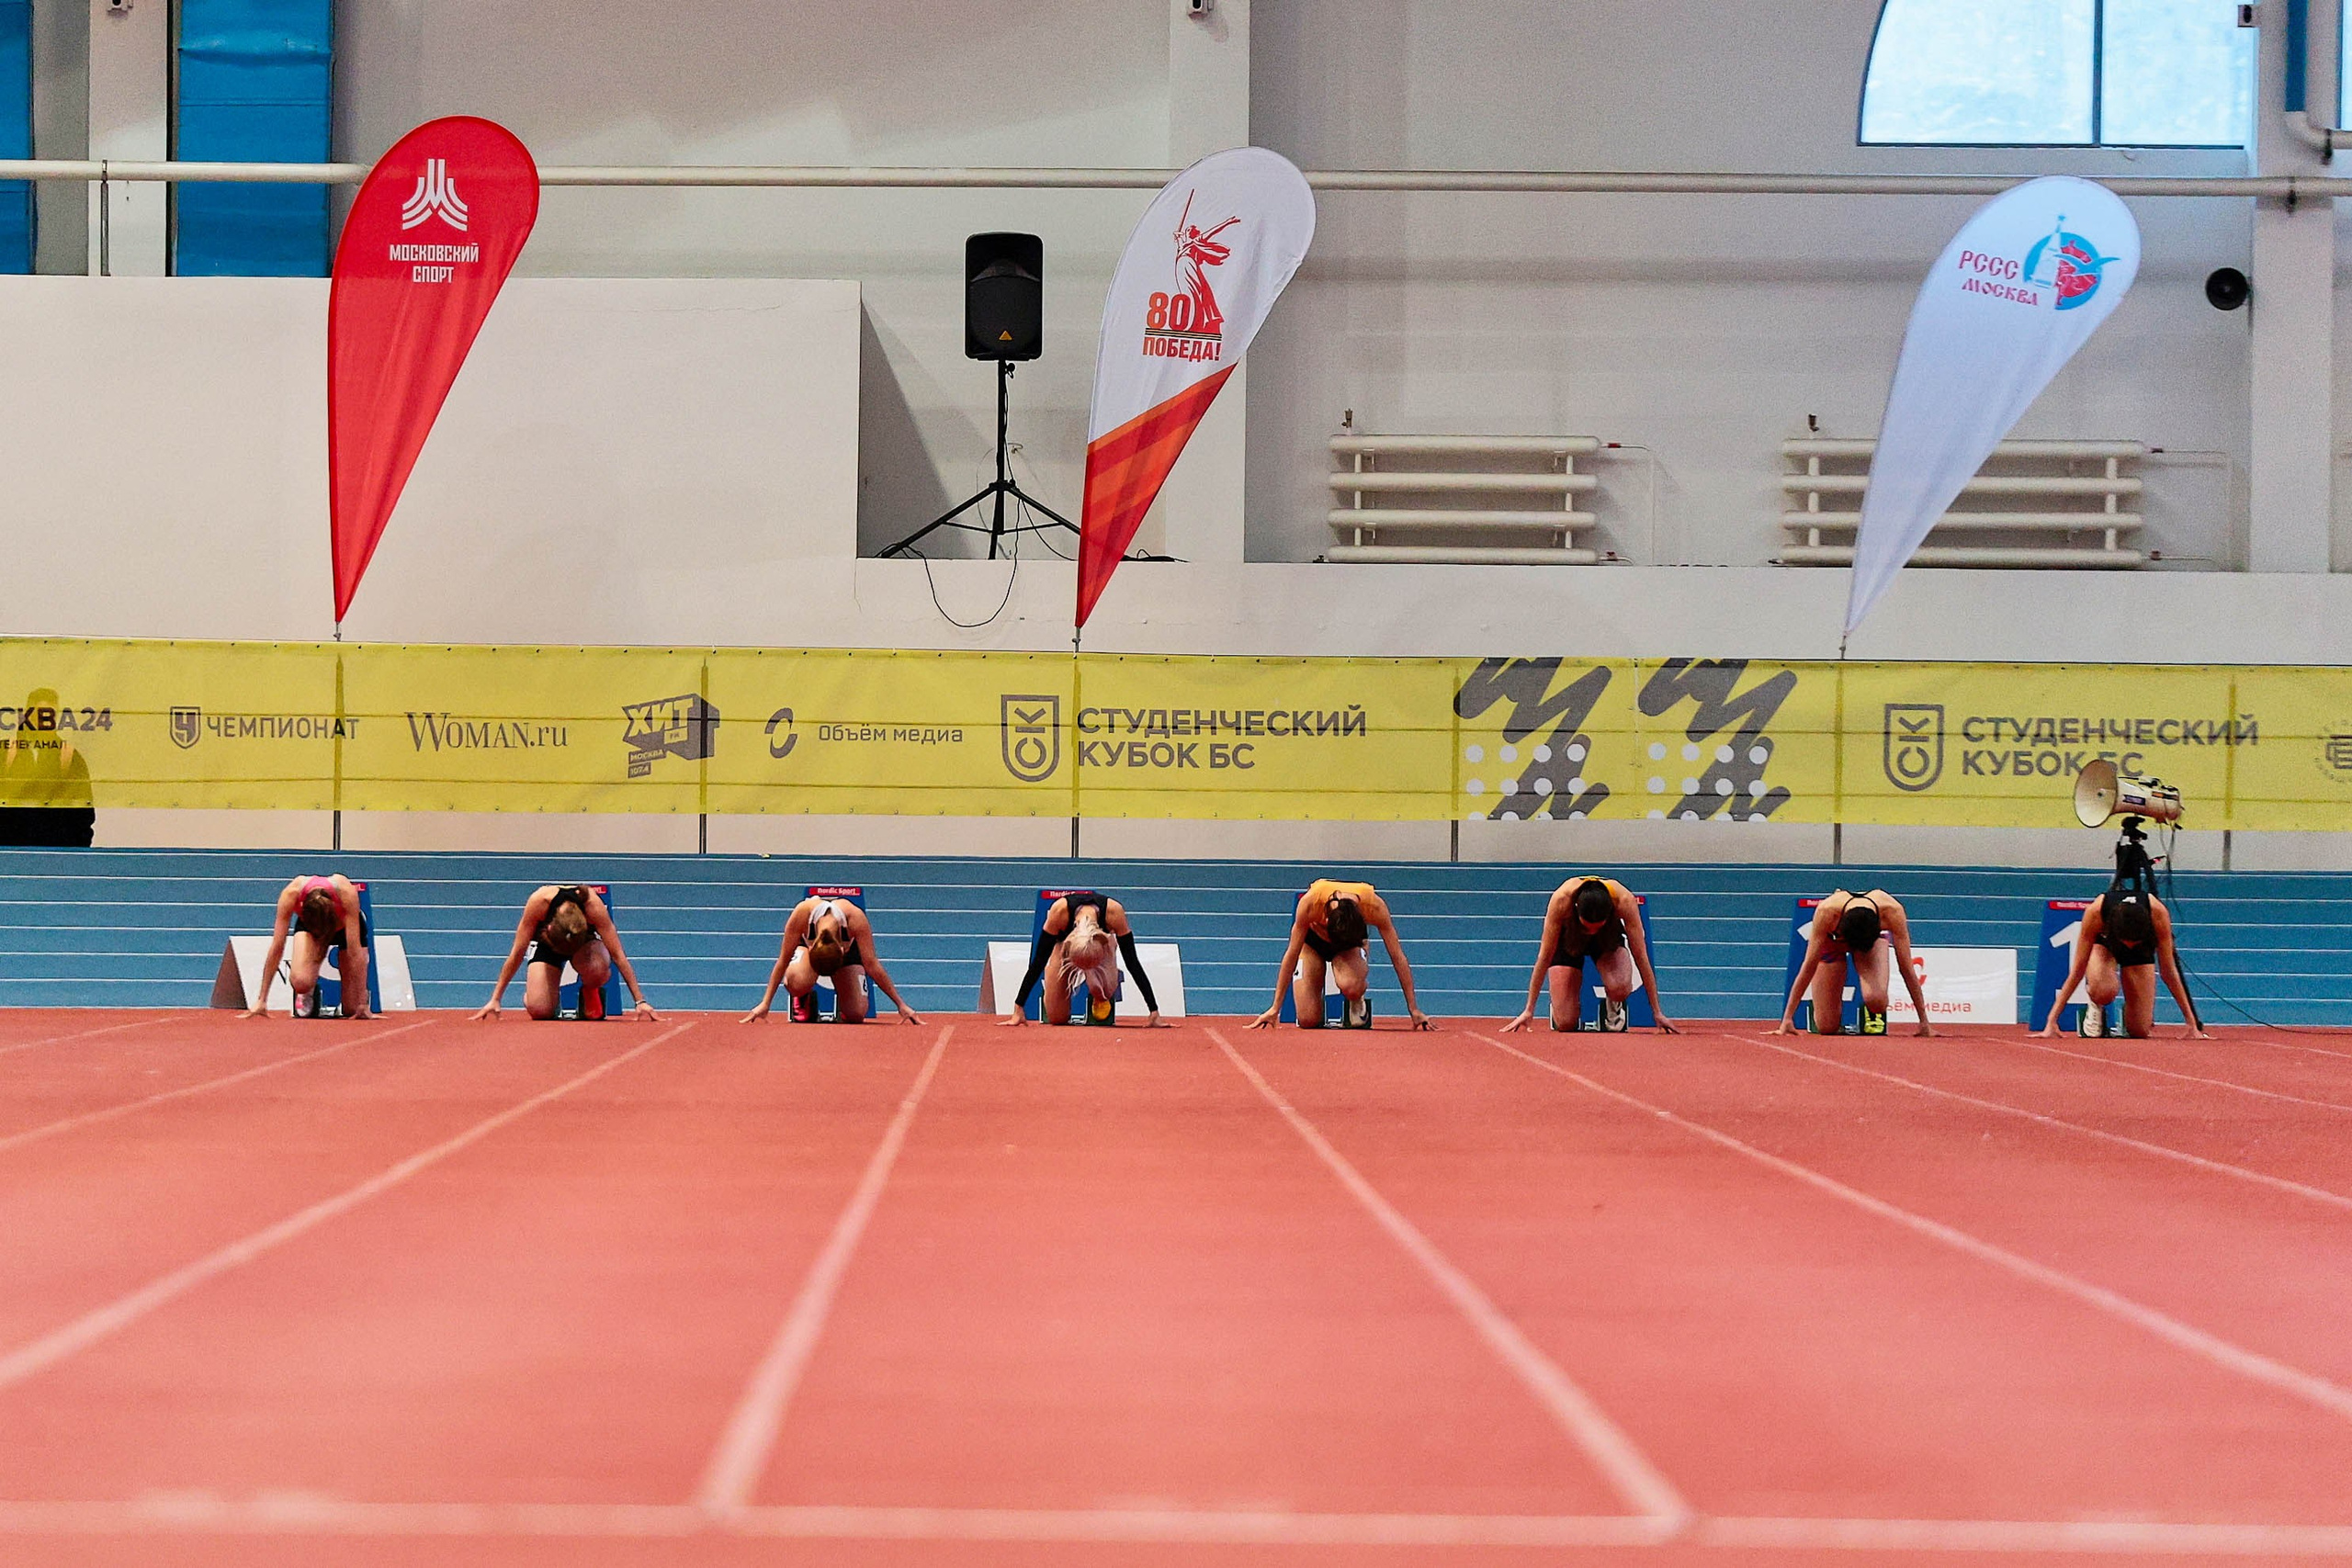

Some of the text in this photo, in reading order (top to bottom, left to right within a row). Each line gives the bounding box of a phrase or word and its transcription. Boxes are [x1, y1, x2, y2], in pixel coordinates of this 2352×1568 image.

[390, 243, 480, 263] МОСКОВСКИЙ
[1958, 250, 2019, 280] РССС
[413, 265, 455, 283] СПОРТ
[1962, 277, 2040, 307] МОСКВА
[1147, 291, 1192, 332] 80
[1142, 336, 1222, 362] ПОБЕДА!
[207, 716, 359, 739] ЧЕМПИОНАТ
[628, 697, 694, 738] ХИТ
[1077, 704, 1366, 739] СТУДЕНЧЕСКИЙ
[1962, 714, 2259, 746] СТУДЕНЧЕСКИЙ
[819, 724, 963, 745] Объём медиа
[1078, 740, 1255, 770] КУБОК БС
[1962, 750, 2084, 777] КУБОК
